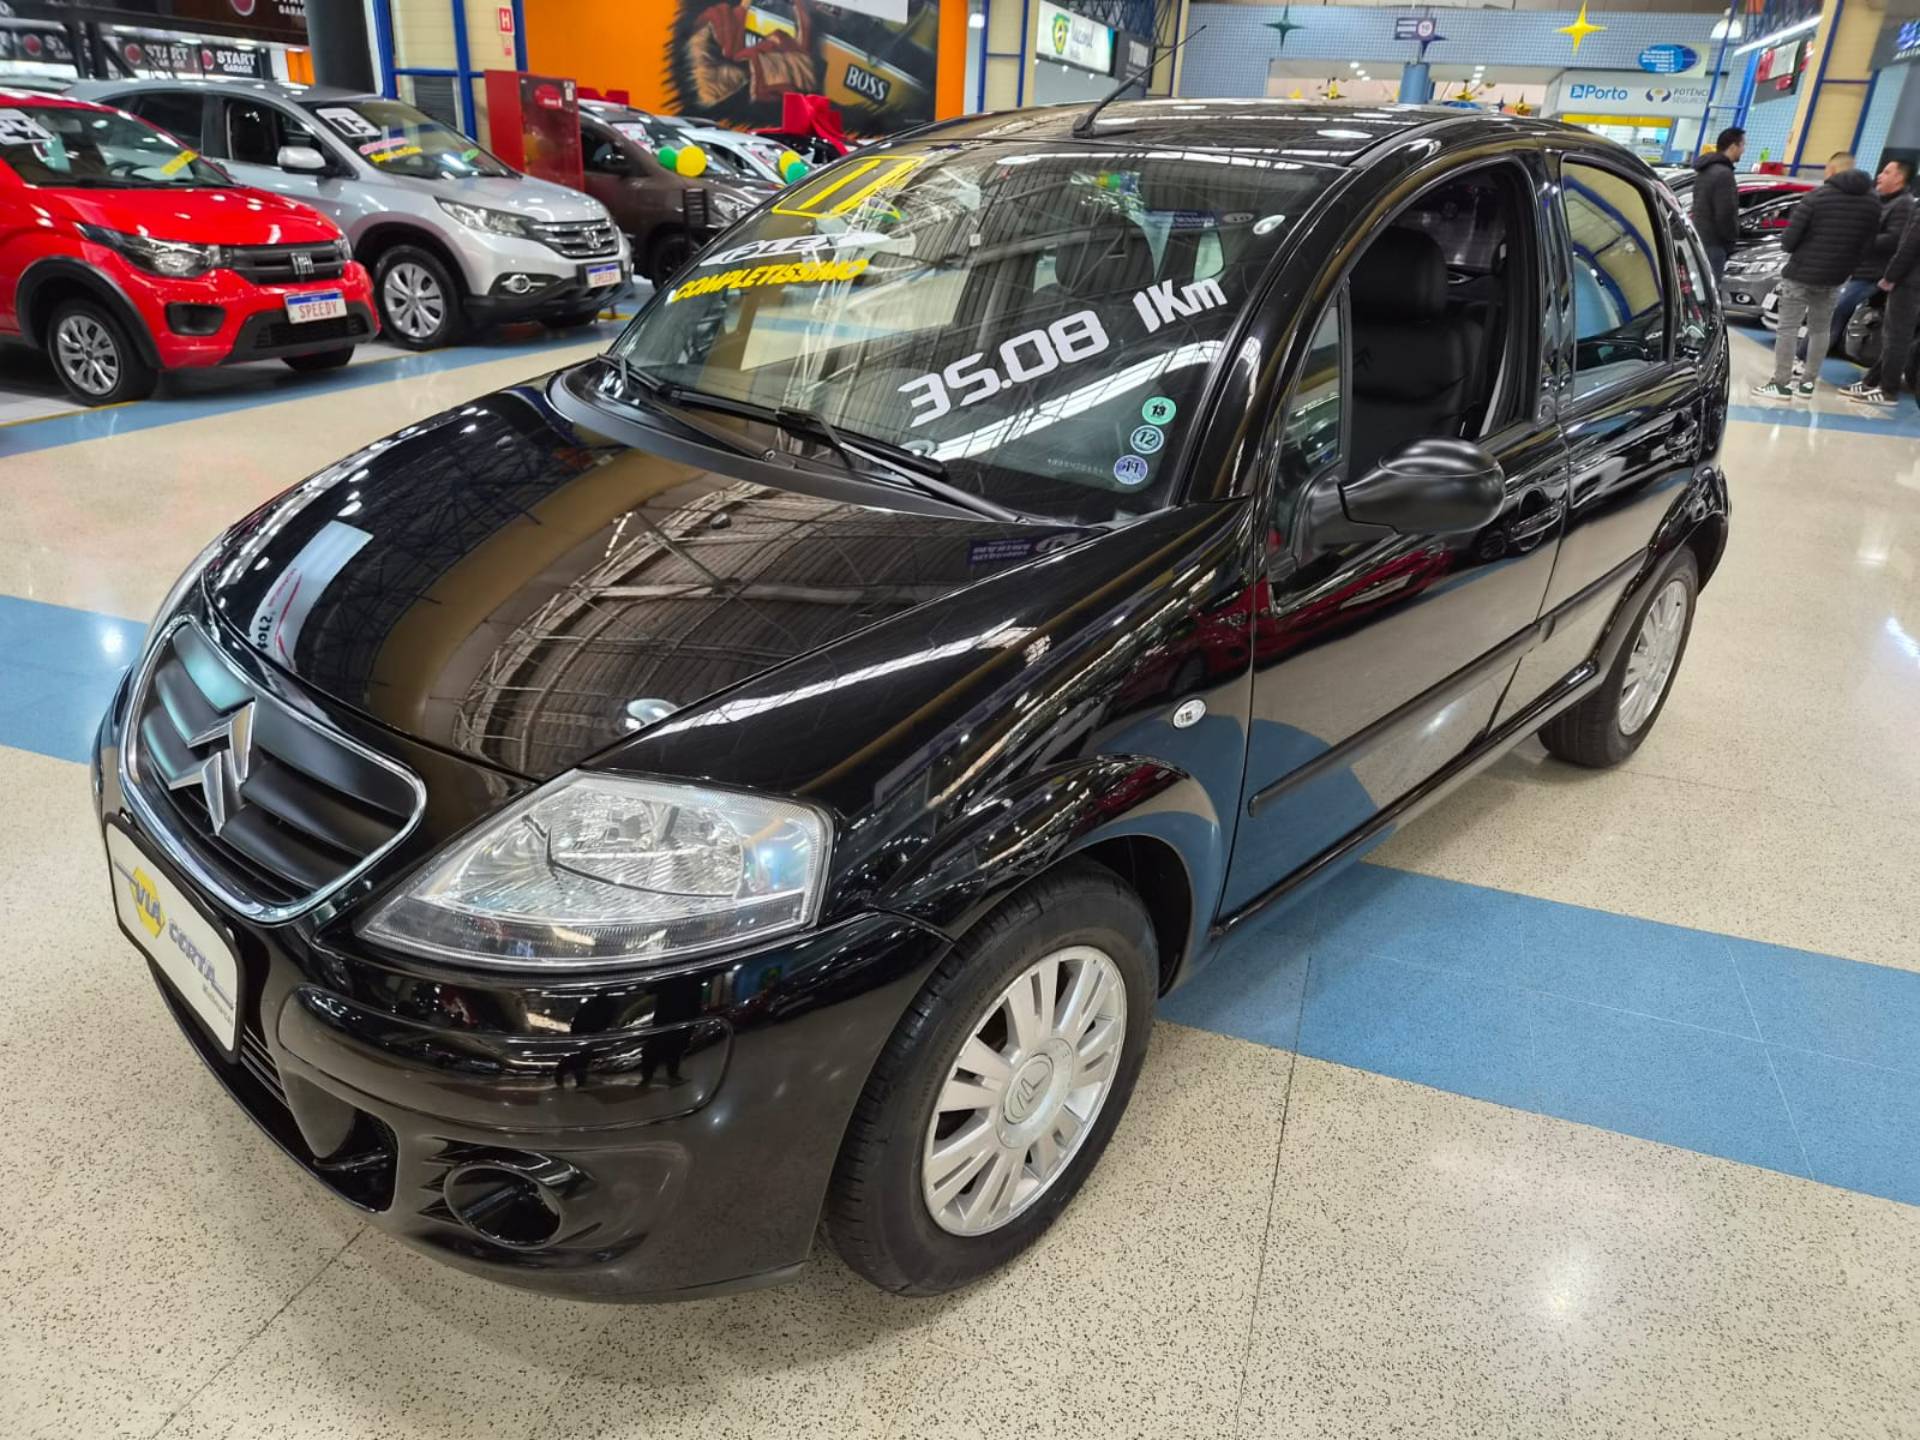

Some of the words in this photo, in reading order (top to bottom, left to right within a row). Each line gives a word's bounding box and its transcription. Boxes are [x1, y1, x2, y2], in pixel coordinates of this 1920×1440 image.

[501, 12, 511, 29] H
[216, 50, 256, 66] START
[223, 63, 253, 74] GARAGE
[847, 66, 887, 101] BOSS
[1585, 84, 1628, 101] Porto
[298, 301, 338, 320] SPEEDY
[897, 310, 1110, 428] 35.08
[1139, 431, 1157, 446] 12
[136, 884, 162, 925] VIA
[169, 919, 216, 982] CERTA
